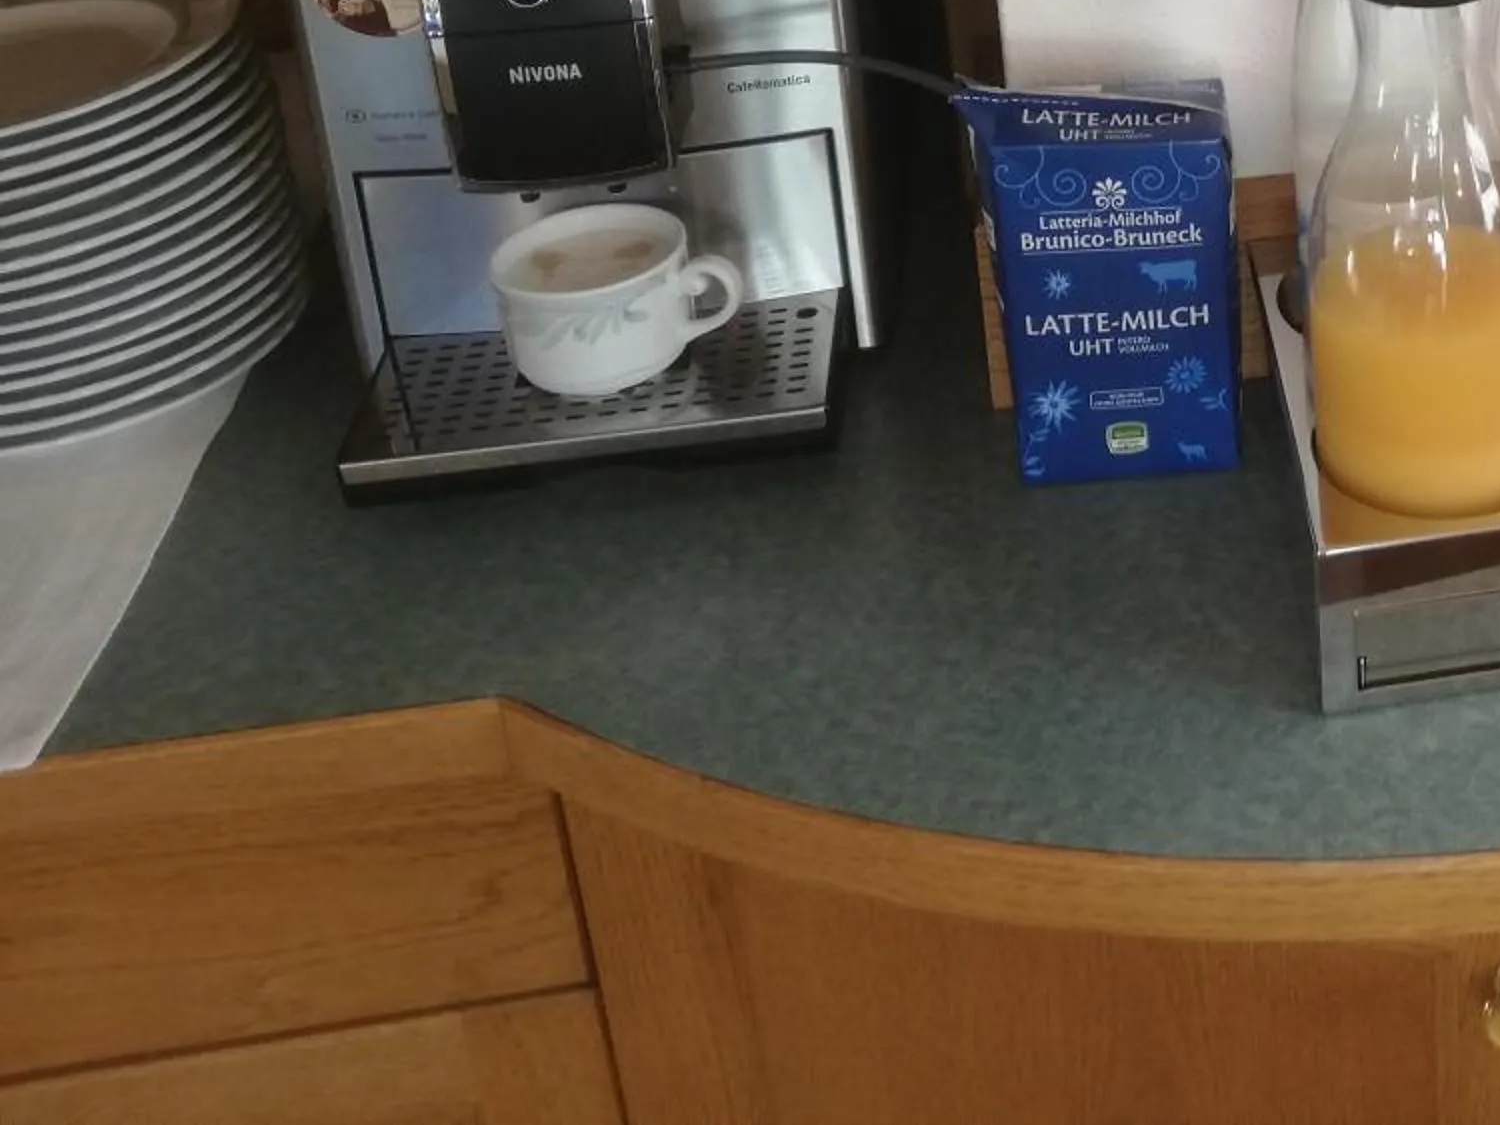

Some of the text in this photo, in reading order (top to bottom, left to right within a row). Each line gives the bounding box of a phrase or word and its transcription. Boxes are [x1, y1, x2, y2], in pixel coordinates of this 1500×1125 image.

[508, 62, 583, 85] NIVONA
[1021, 108, 1191, 127] LATTE-MILCH
[1059, 128, 1099, 142] UHT
[1039, 207, 1183, 231] Latteria-Milchhof
[1021, 222, 1204, 252] Brunico-Bruneck
[1025, 303, 1210, 337] LATTE-MILCH
[1069, 337, 1114, 356] UHT
